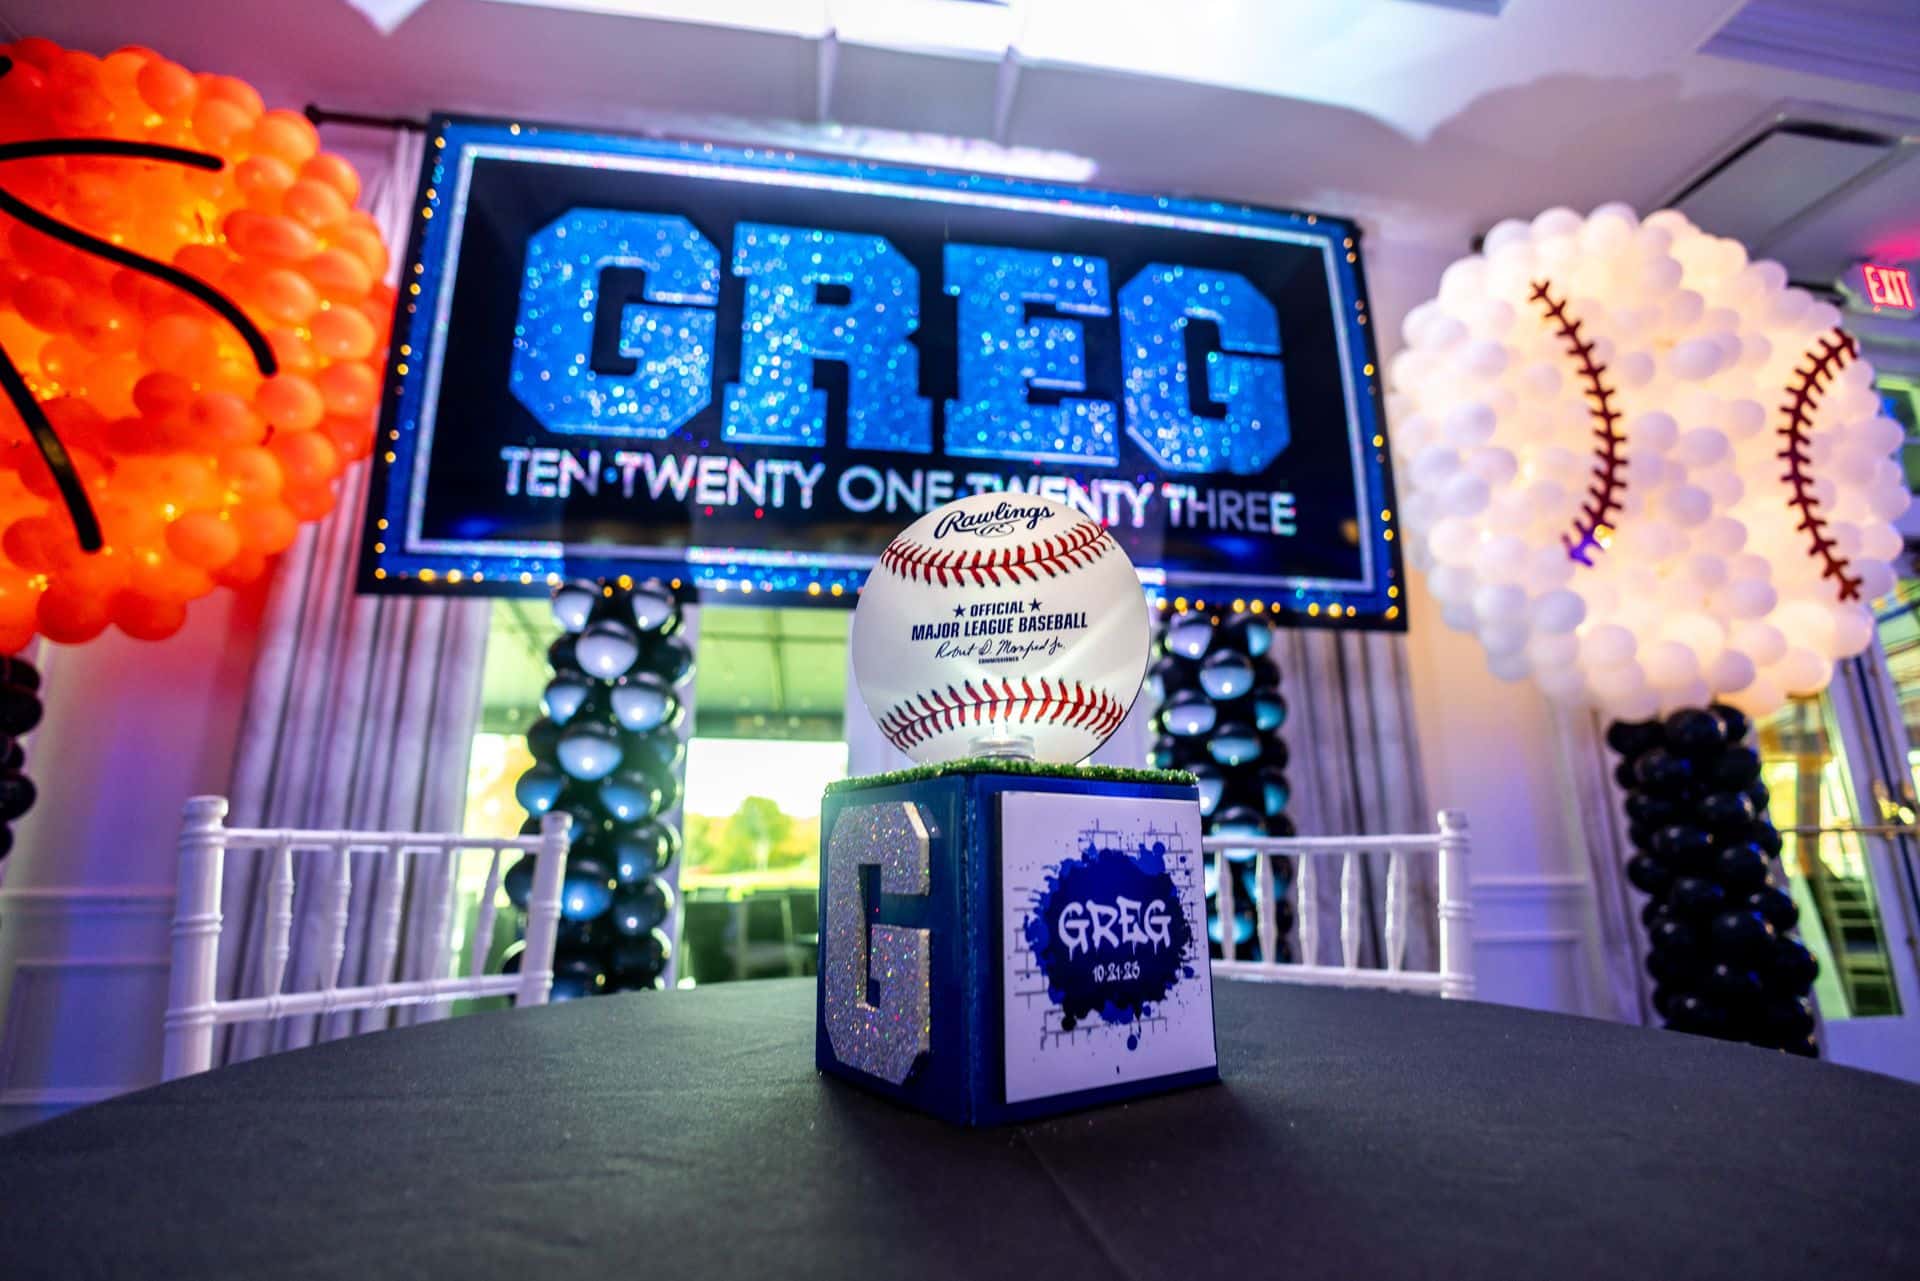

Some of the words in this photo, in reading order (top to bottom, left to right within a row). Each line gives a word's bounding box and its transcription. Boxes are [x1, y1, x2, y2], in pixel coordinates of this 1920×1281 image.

[1863, 264, 1915, 309] EXIT
[508, 207, 1292, 476] GREG
[933, 502, 1055, 539] Rawlings
[1162, 482, 1297, 536] THREE
[911, 622, 960, 641] MAJOR
[964, 617, 1014, 637] LEAGUE
[1018, 612, 1088, 633] BASEBALL
[970, 600, 1024, 617] OFFICIAL
[824, 800, 932, 1086] G
[1058, 895, 1171, 961] GREG
